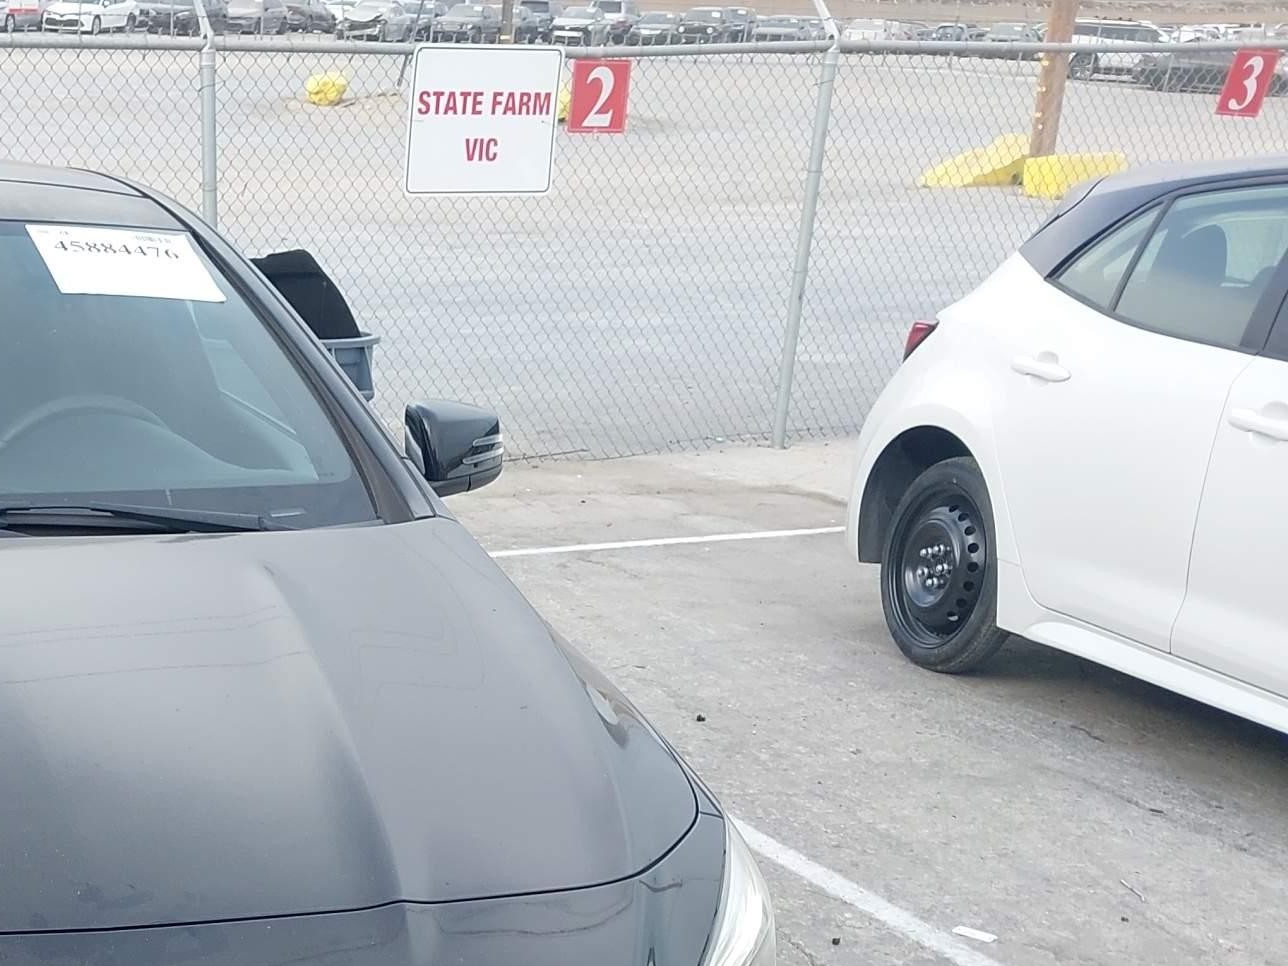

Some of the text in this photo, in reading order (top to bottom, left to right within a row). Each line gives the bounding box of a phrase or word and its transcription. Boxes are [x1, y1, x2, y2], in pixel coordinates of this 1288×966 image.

[581, 66, 615, 127] 2
[1228, 56, 1264, 110] 3
[417, 91, 552, 115] STATE FARM
[465, 138, 499, 161] VIC
